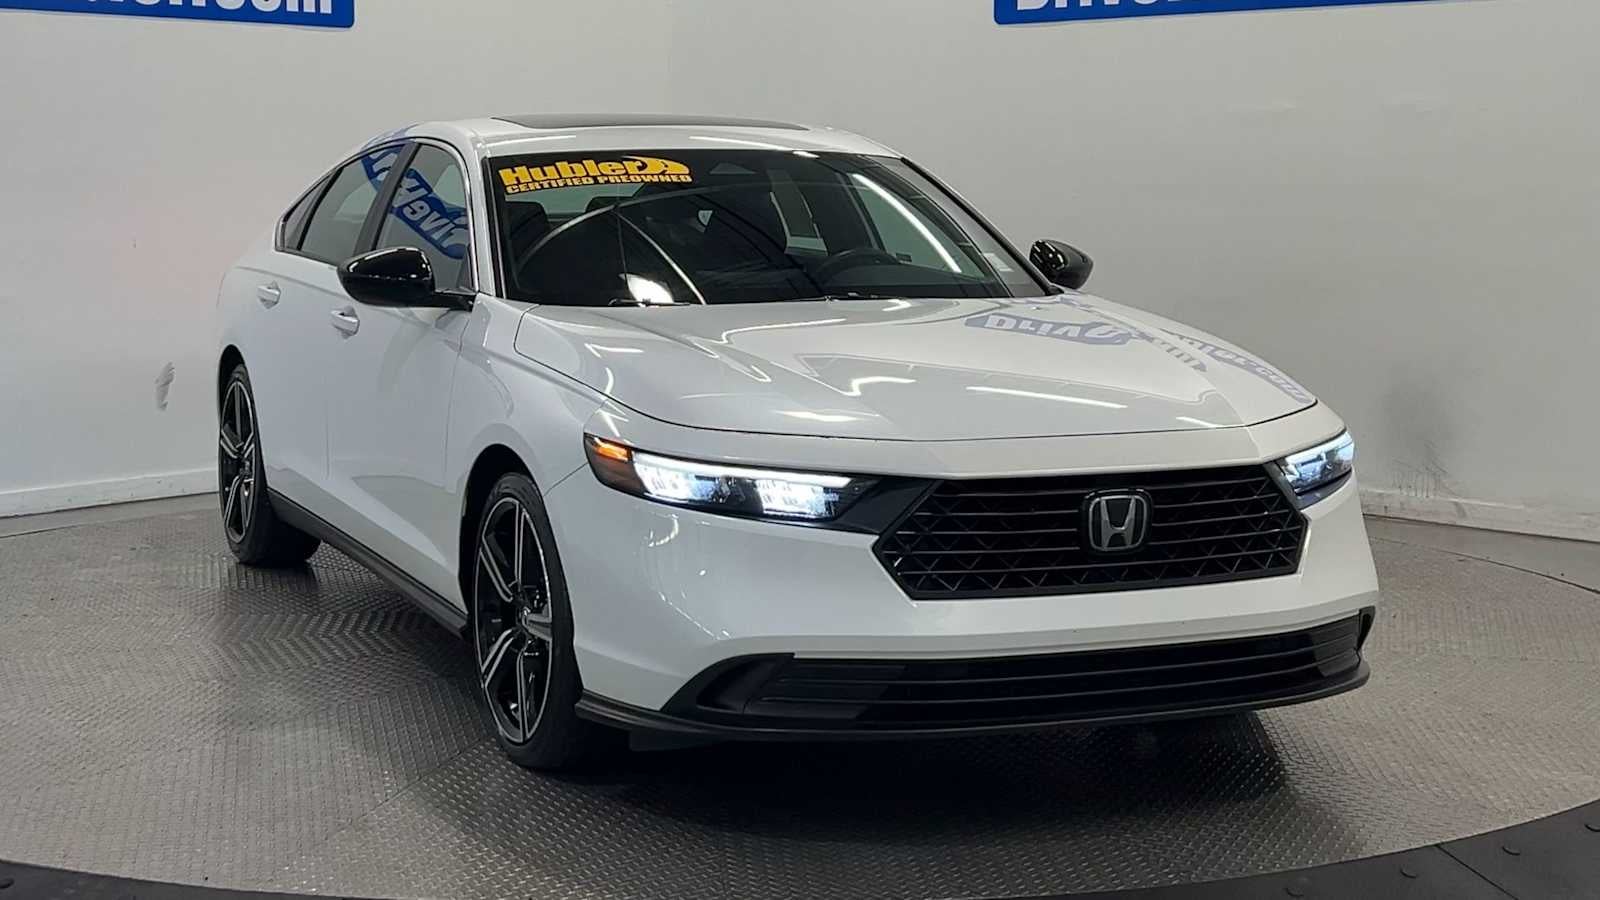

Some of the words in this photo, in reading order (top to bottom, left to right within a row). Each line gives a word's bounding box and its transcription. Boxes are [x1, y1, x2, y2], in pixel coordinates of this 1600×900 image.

[499, 159, 644, 186] Hubler
[506, 177, 595, 194] CERTIFIED
[597, 174, 693, 184] PREOWNED
